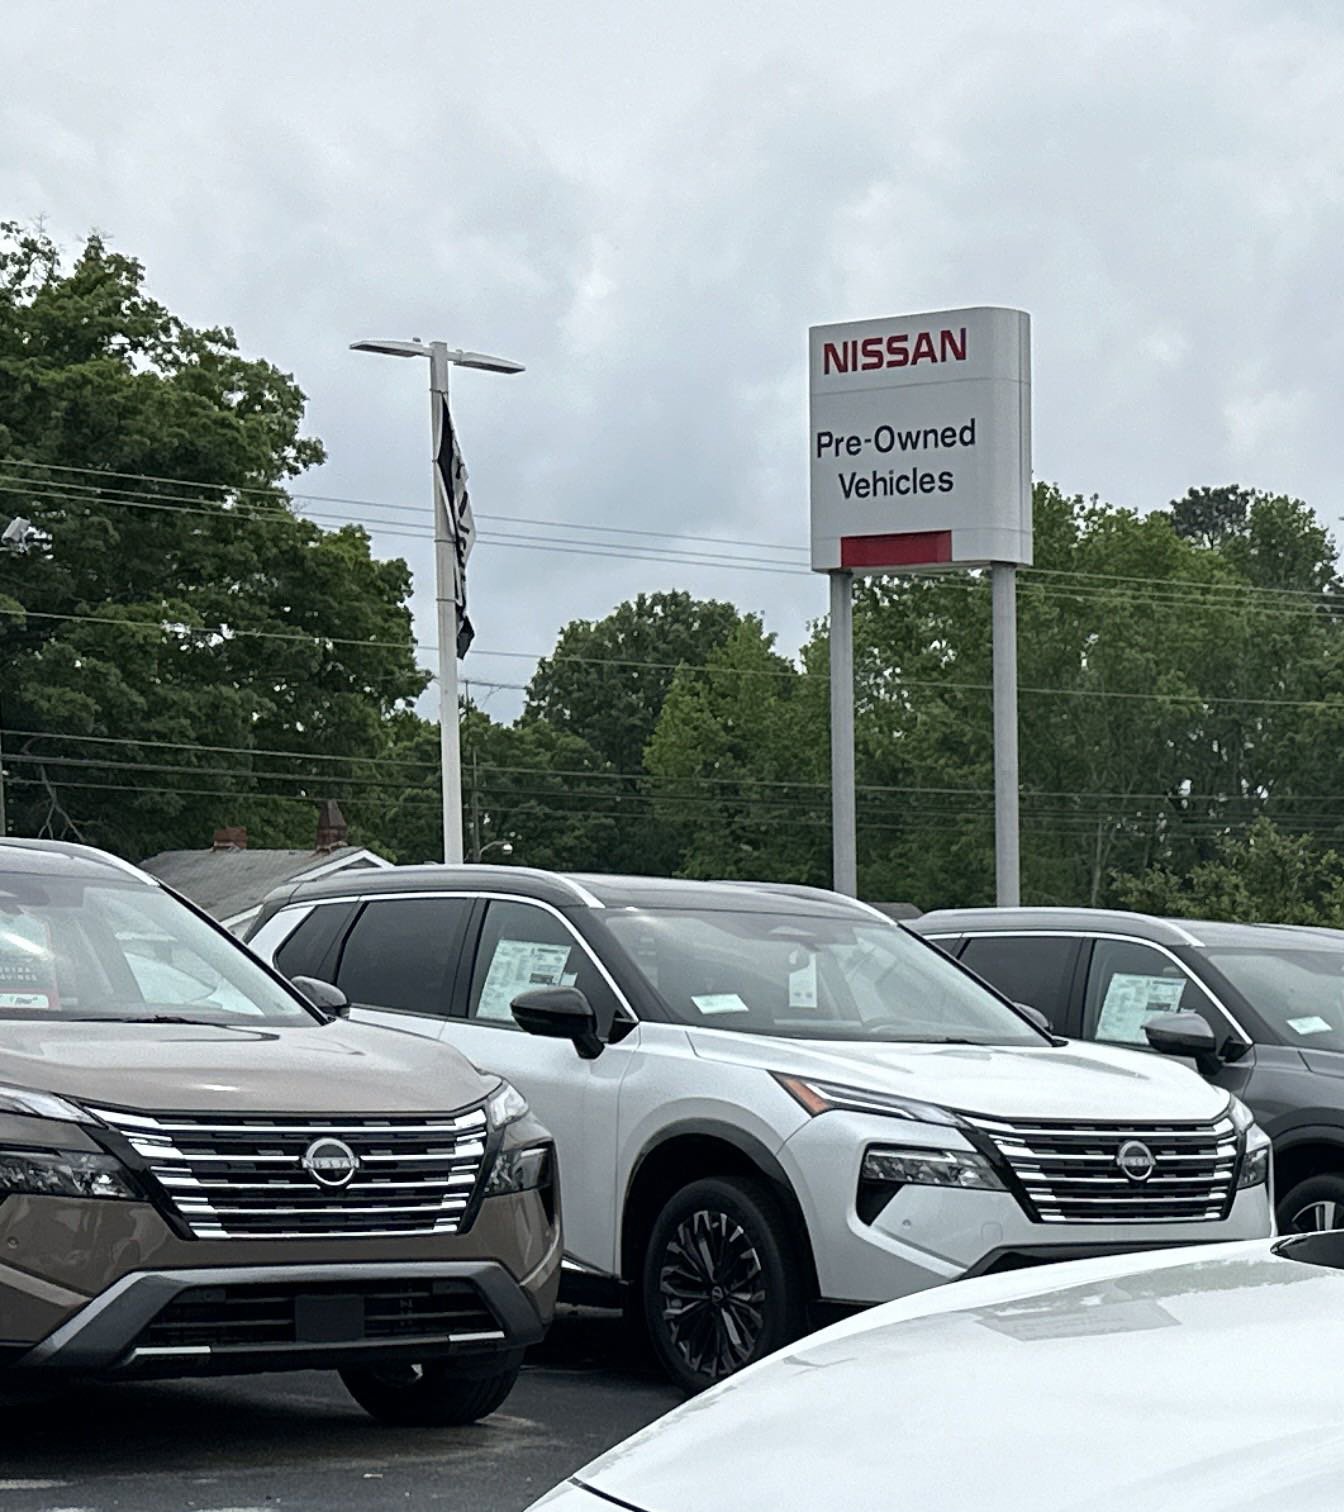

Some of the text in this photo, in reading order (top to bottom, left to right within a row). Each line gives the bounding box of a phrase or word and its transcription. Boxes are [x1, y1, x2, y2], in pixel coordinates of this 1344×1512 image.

[823, 328, 967, 375] NISSAN
[816, 418, 976, 458] Pre-Owned
[838, 468, 954, 500] Vehicles
[302, 1157, 360, 1169] NISSAN
